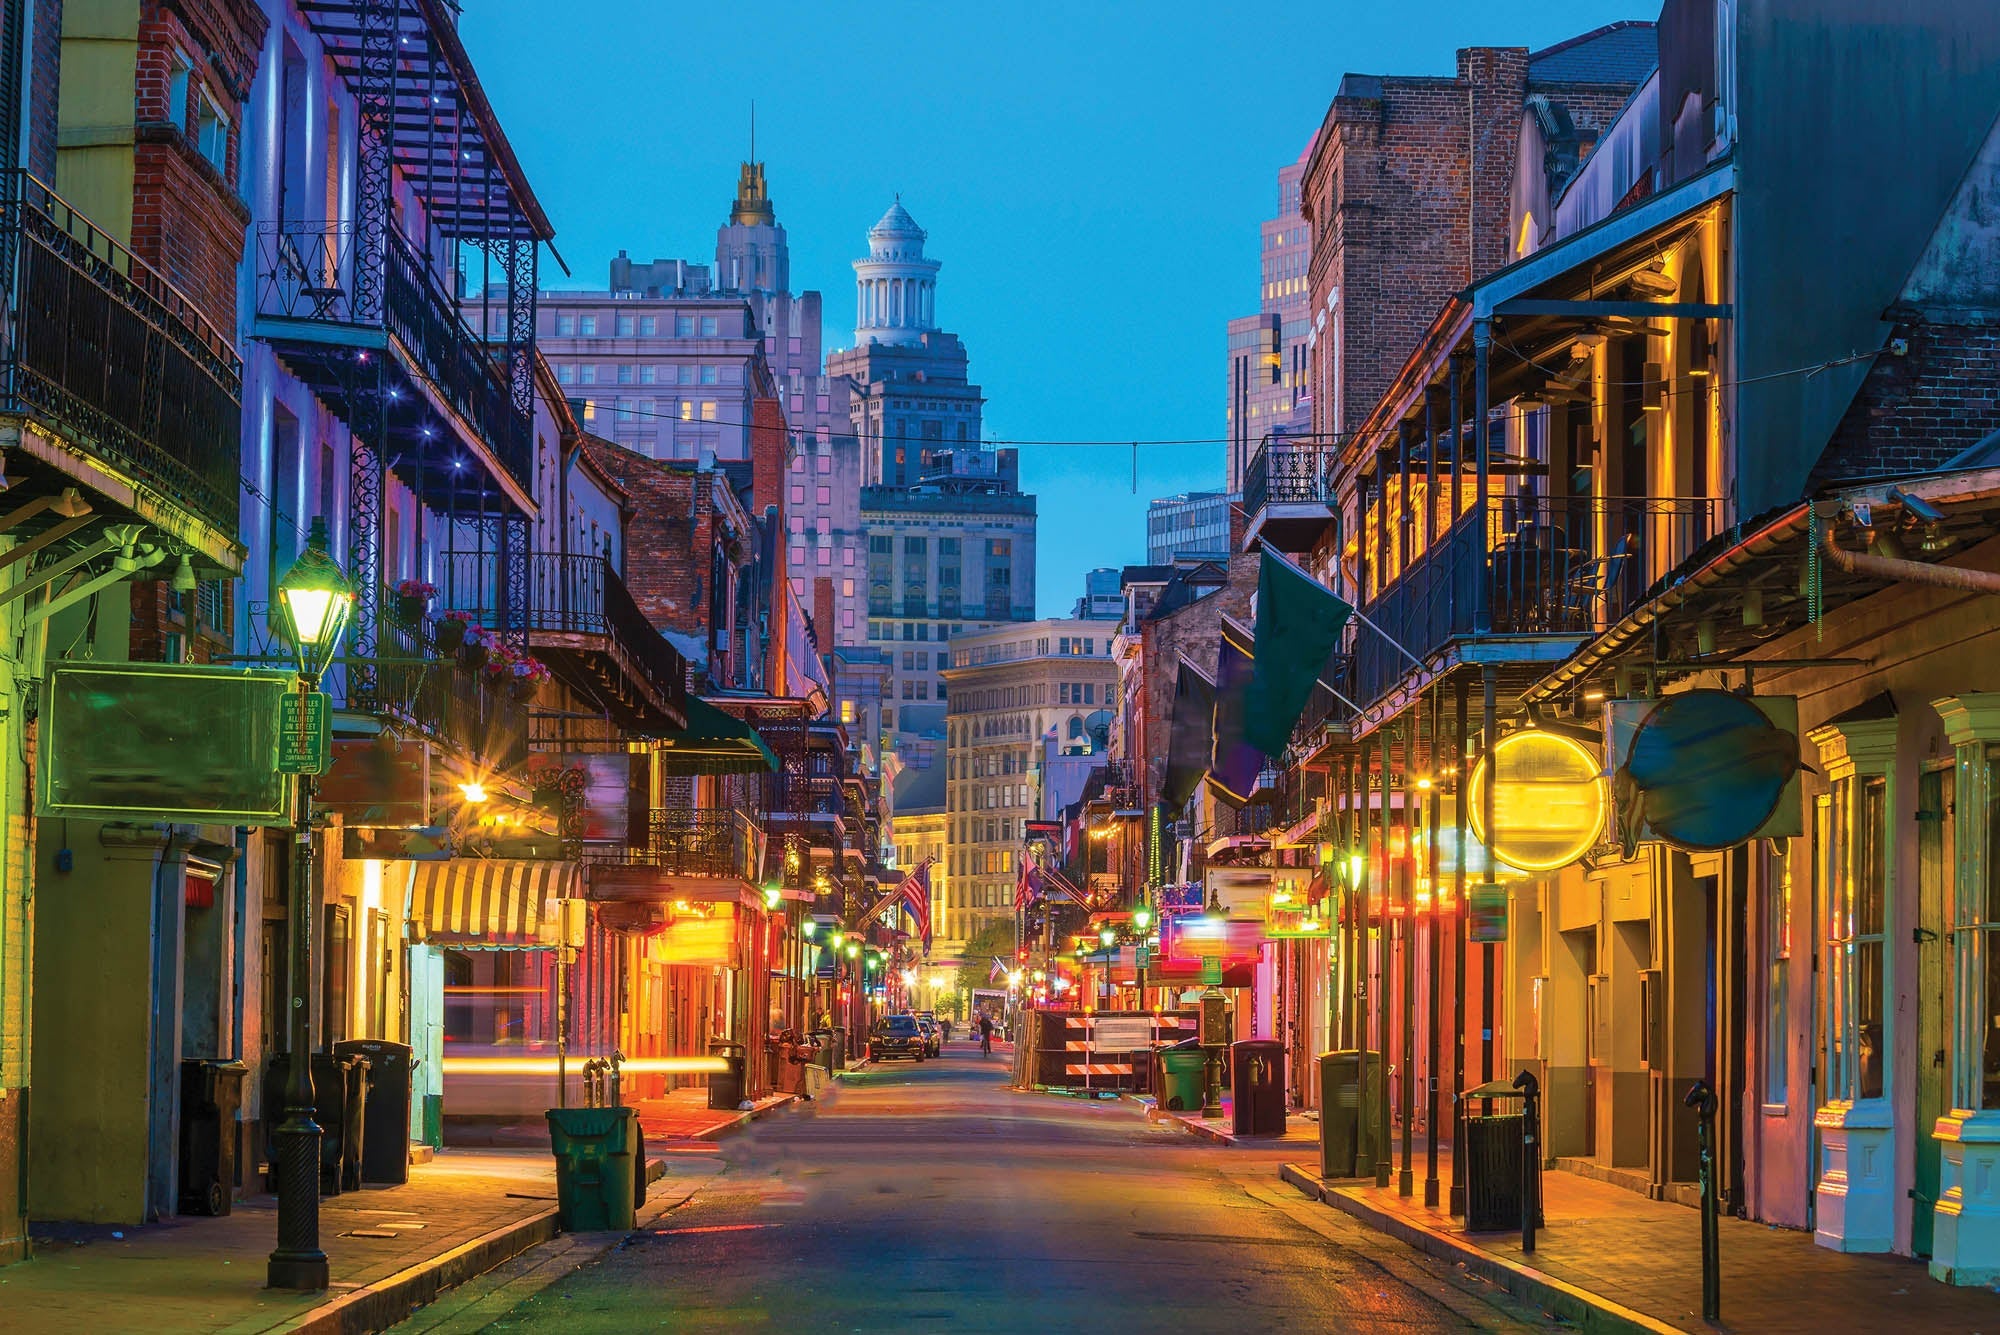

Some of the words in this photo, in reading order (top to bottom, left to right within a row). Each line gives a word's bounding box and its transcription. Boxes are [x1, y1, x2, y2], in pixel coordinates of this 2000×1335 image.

[294, 700, 319, 708] BTLES
[288, 715, 314, 723] ALLED
[295, 722, 316, 730] SEET
